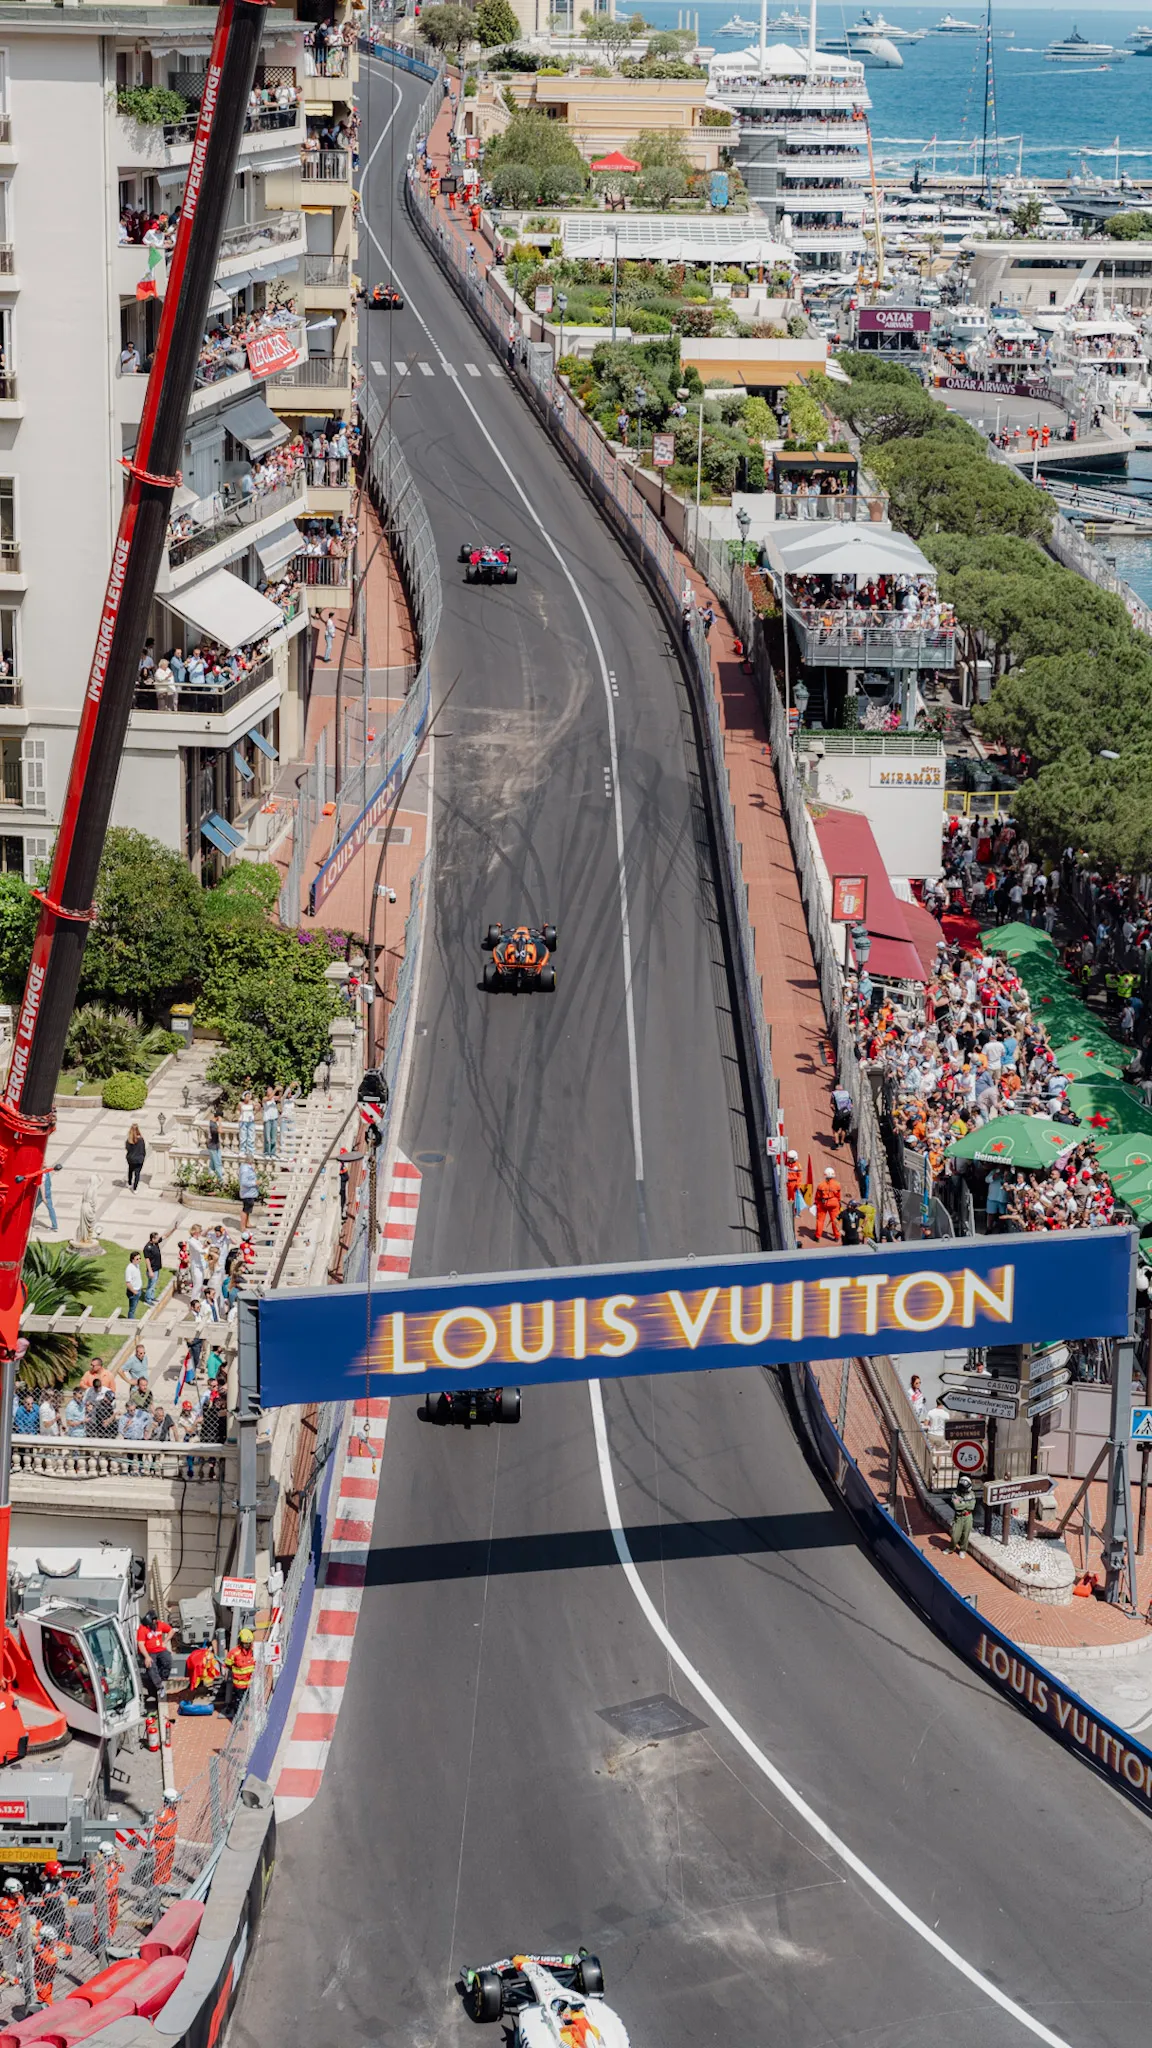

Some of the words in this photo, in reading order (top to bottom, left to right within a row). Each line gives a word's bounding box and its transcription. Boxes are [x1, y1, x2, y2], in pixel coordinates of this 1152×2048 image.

[183, 138, 208, 220] IMPERIAL
[199, 64, 221, 133] LEVAGE
[876, 312, 914, 324] QATAR
[884, 321, 914, 329] AIRWAYS
[946, 377, 976, 390] QATAR
[978, 381, 1016, 395] AIRWAYS
[1028, 386, 1050, 399] QATAR
[87, 615, 116, 703] IMPERIAL
[105, 537, 131, 611] LEVAGE
[880, 772, 941, 783] MIRAMAR
[321, 837, 354, 895] LOUIS
[355, 774, 397, 845] VUITTON
[19, 962, 46, 1041] LEVAGE
[974, 1151, 1013, 1165] Heineken
[391, 1294, 639, 1374] LOUIS
[667, 1264, 1015, 1350] VUITTON
[987, 1381, 1015, 1390] CASINO
[966, 1397, 1014, 1411] Cardiothoracique
[998, 1485, 1021, 1494] Miramar
[980, 1633, 1049, 1714] LOUIS
[1054, 1691, 1152, 1799] VUITTO
[0, 1805, 24, 1814] .13.73
[0, 1850, 54, 1859] EPTIONNEL
[541, 1956, 562, 1964] Cash
